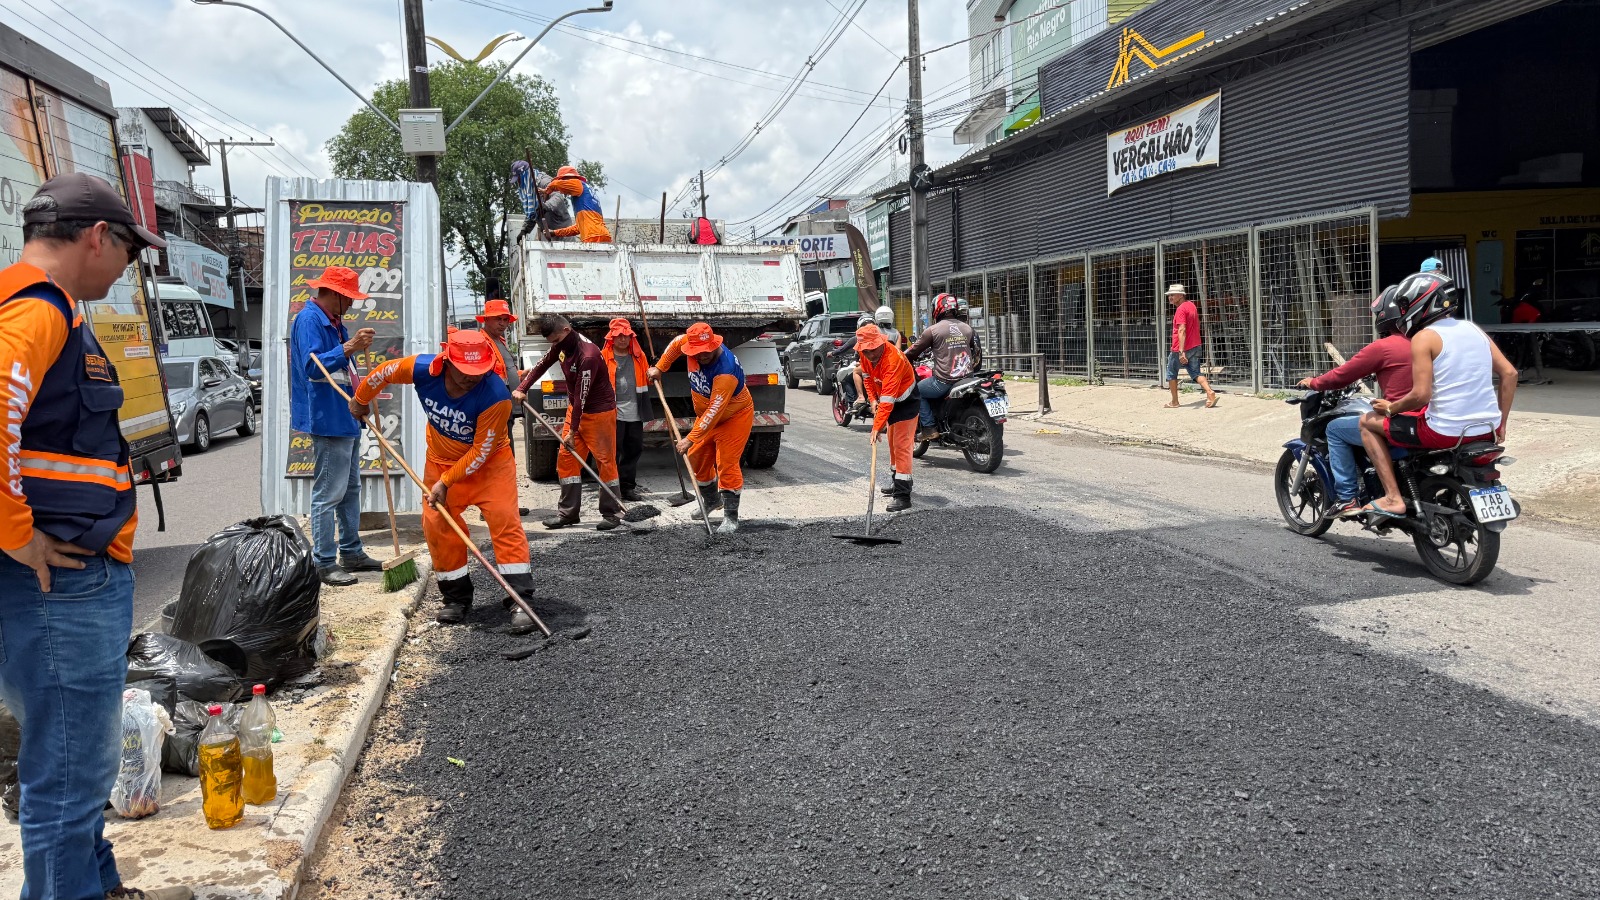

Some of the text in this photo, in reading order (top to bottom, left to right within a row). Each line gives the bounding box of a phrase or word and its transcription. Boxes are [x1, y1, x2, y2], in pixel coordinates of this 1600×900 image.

[1027, 7, 1066, 54] Rio Negro
[1113, 122, 1193, 176] VERGALHÃO
[298, 203, 393, 225] Promoção
[292, 229, 398, 257] TELHAS
[424, 397, 467, 423] PLANO
[1480, 493, 1503, 506] TAB
